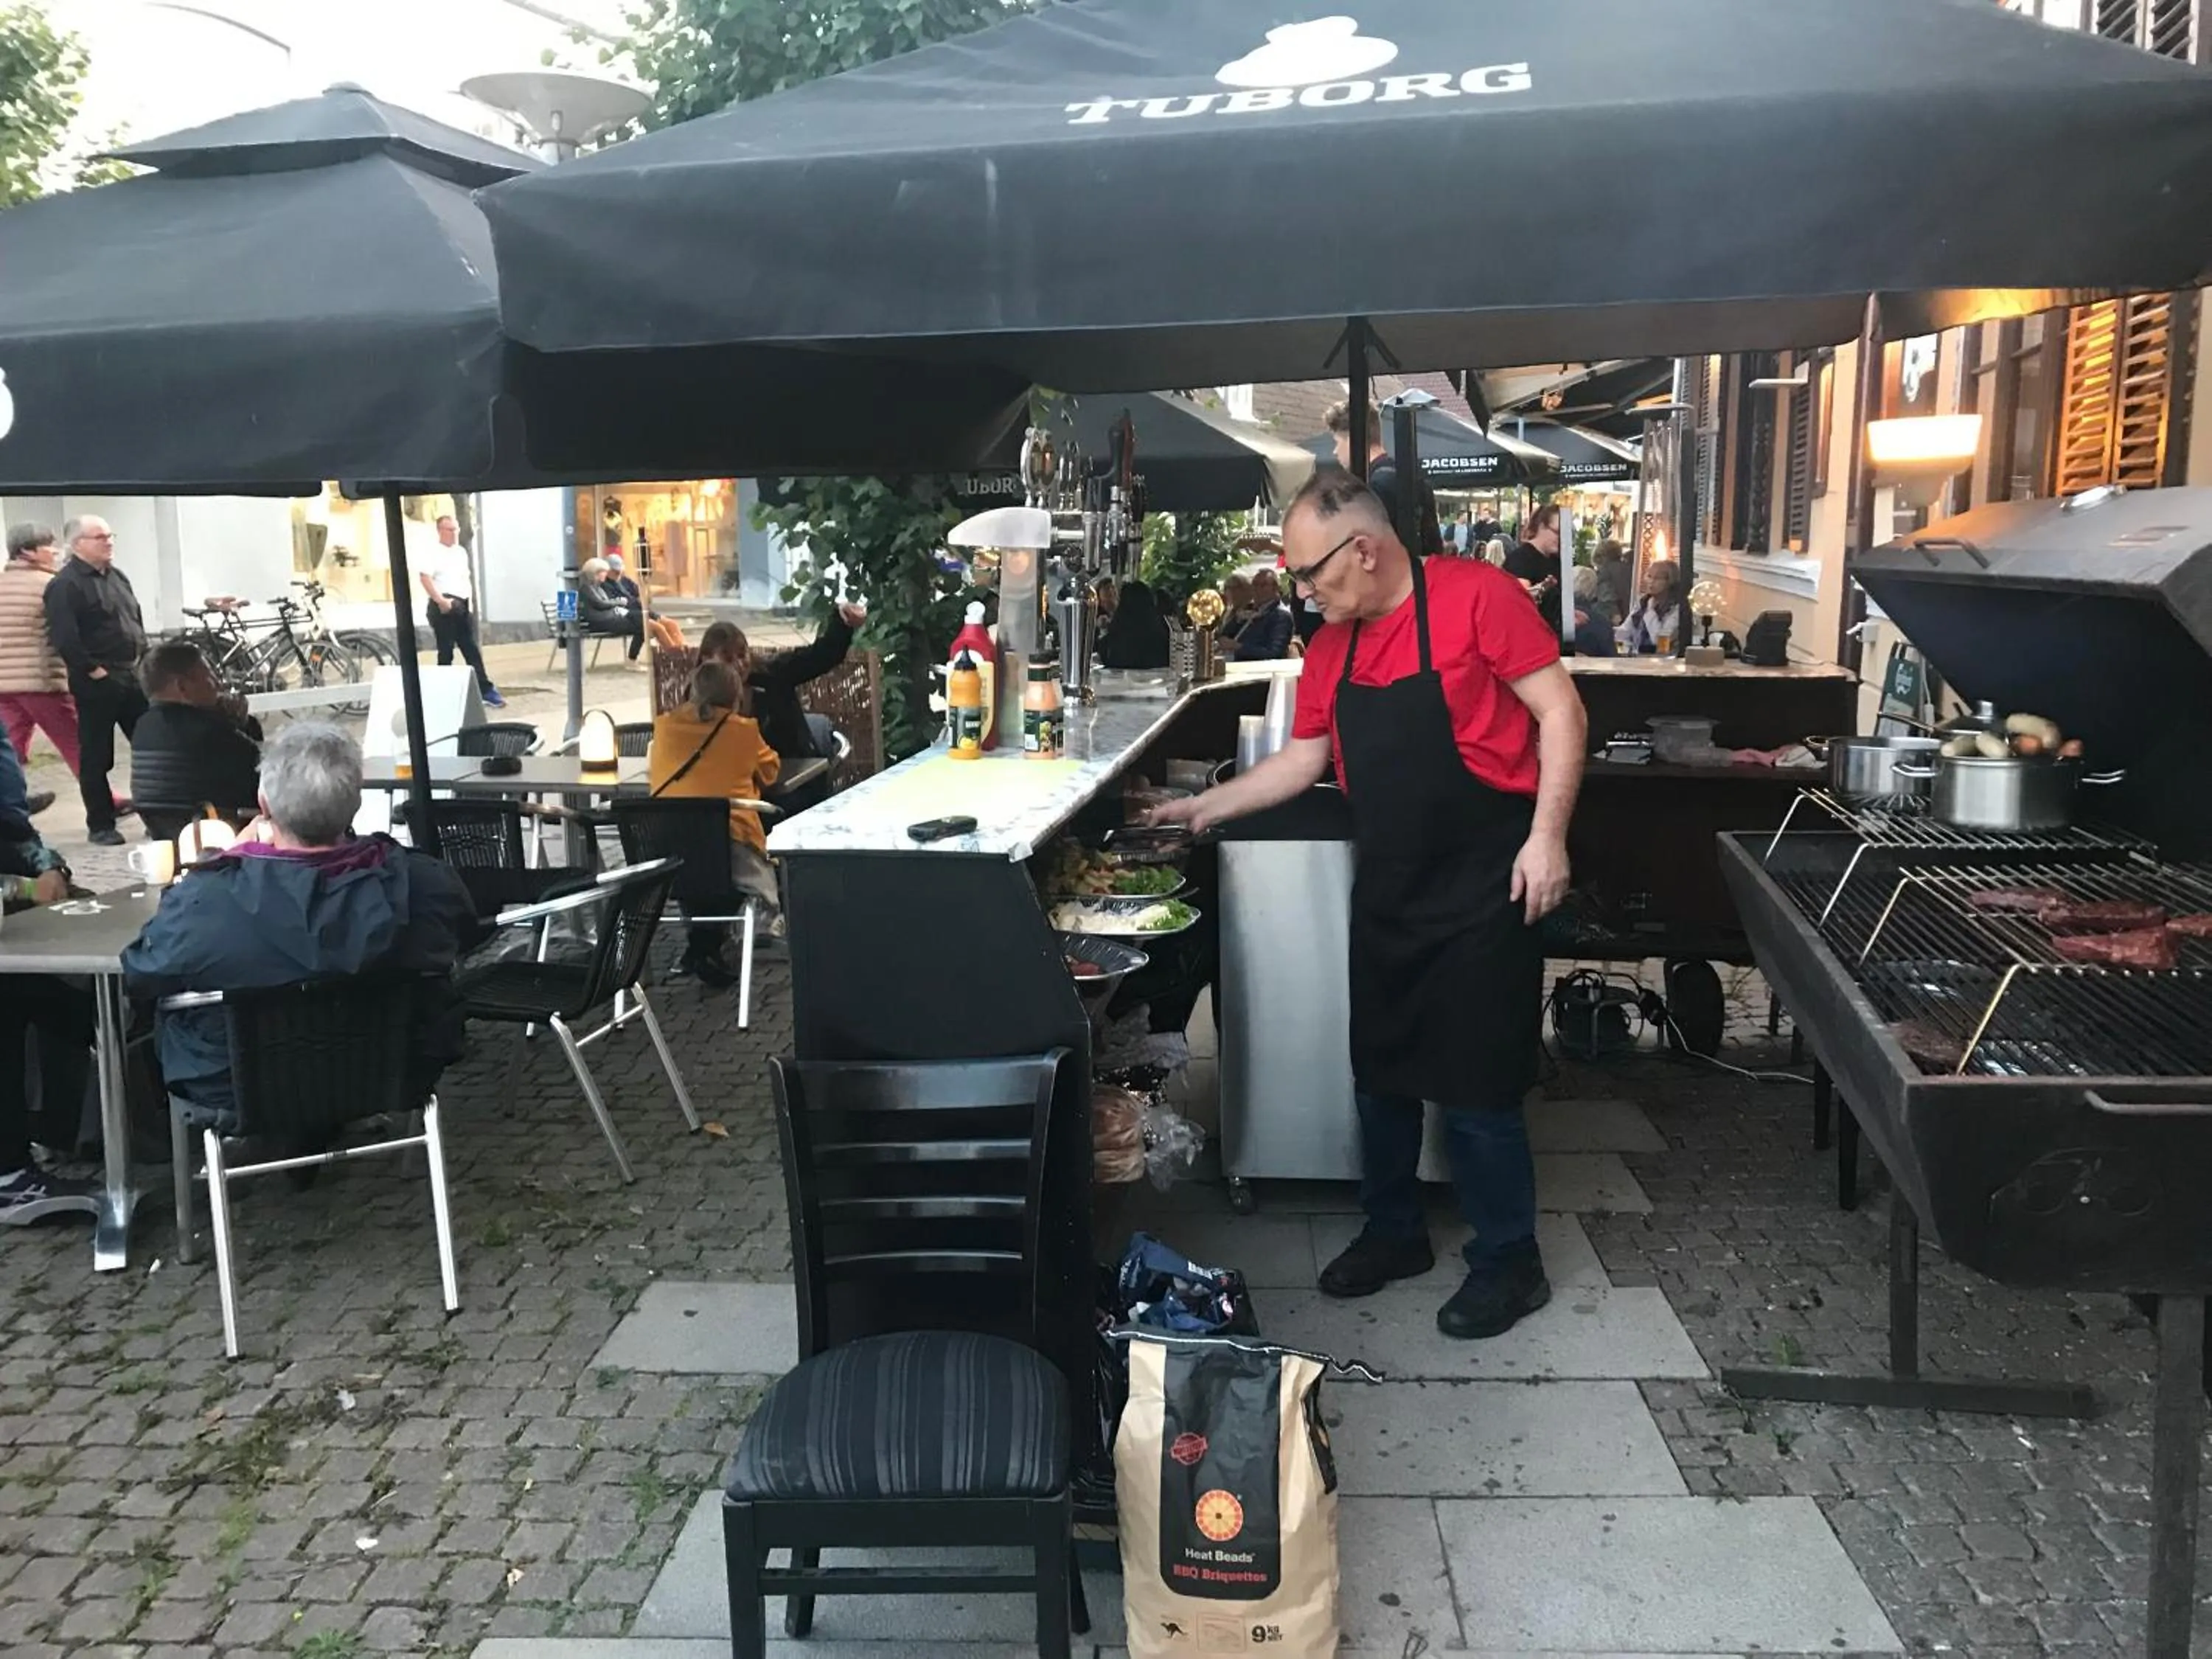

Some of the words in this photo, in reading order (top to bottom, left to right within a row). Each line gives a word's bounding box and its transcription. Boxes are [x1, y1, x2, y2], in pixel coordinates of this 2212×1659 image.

[1064, 62, 1532, 125] TUBORG
[1421, 456, 1498, 468] JACOBSEN
[1559, 463, 1627, 473] JACOBSEN
[957, 476, 1017, 495] UBOR
[1185, 1548, 1212, 1561] Heat
[1215, 1550, 1253, 1563] Beads
[1173, 1564, 1199, 1579] BBQ
[1202, 1568, 1267, 1583] Briquettes
[1251, 1625, 1266, 1643] 9
